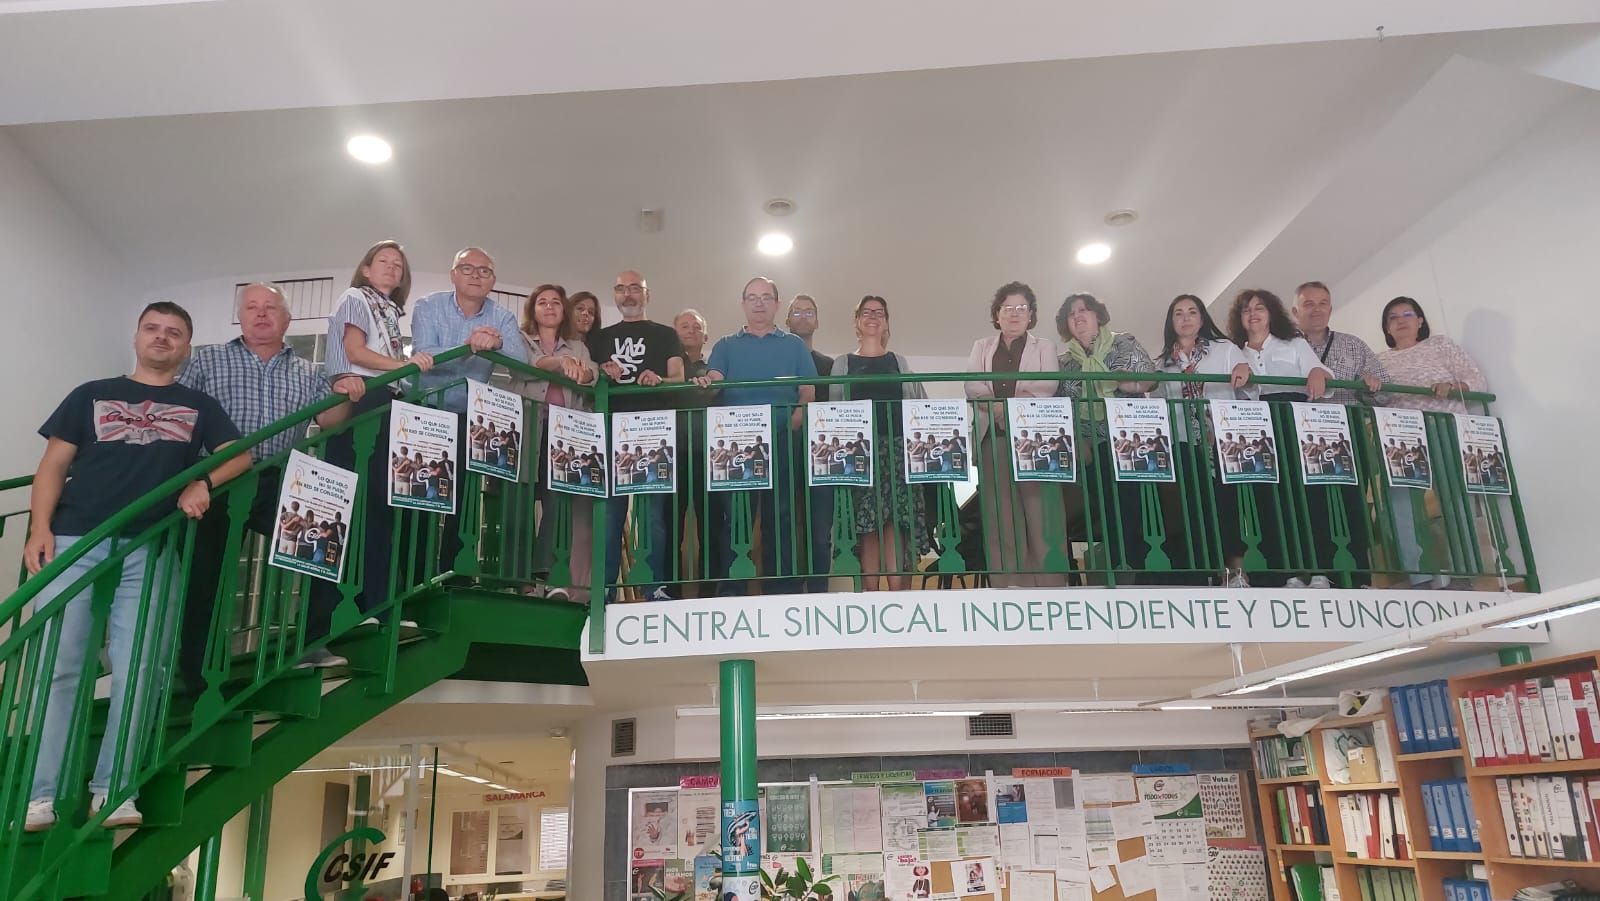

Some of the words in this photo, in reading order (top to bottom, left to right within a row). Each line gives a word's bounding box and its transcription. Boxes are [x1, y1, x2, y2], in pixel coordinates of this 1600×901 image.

[616, 608, 770, 645] CENTRAL
[784, 602, 947, 637] SINDICAL
[962, 600, 1231, 632] INDEPENDIENTE
[1237, 600, 1257, 629] Y
[1270, 599, 1310, 629] DE
[1321, 599, 1538, 630] FUNCION
[485, 792, 545, 802] SALAMANCA
[324, 852, 395, 883] CSIF
